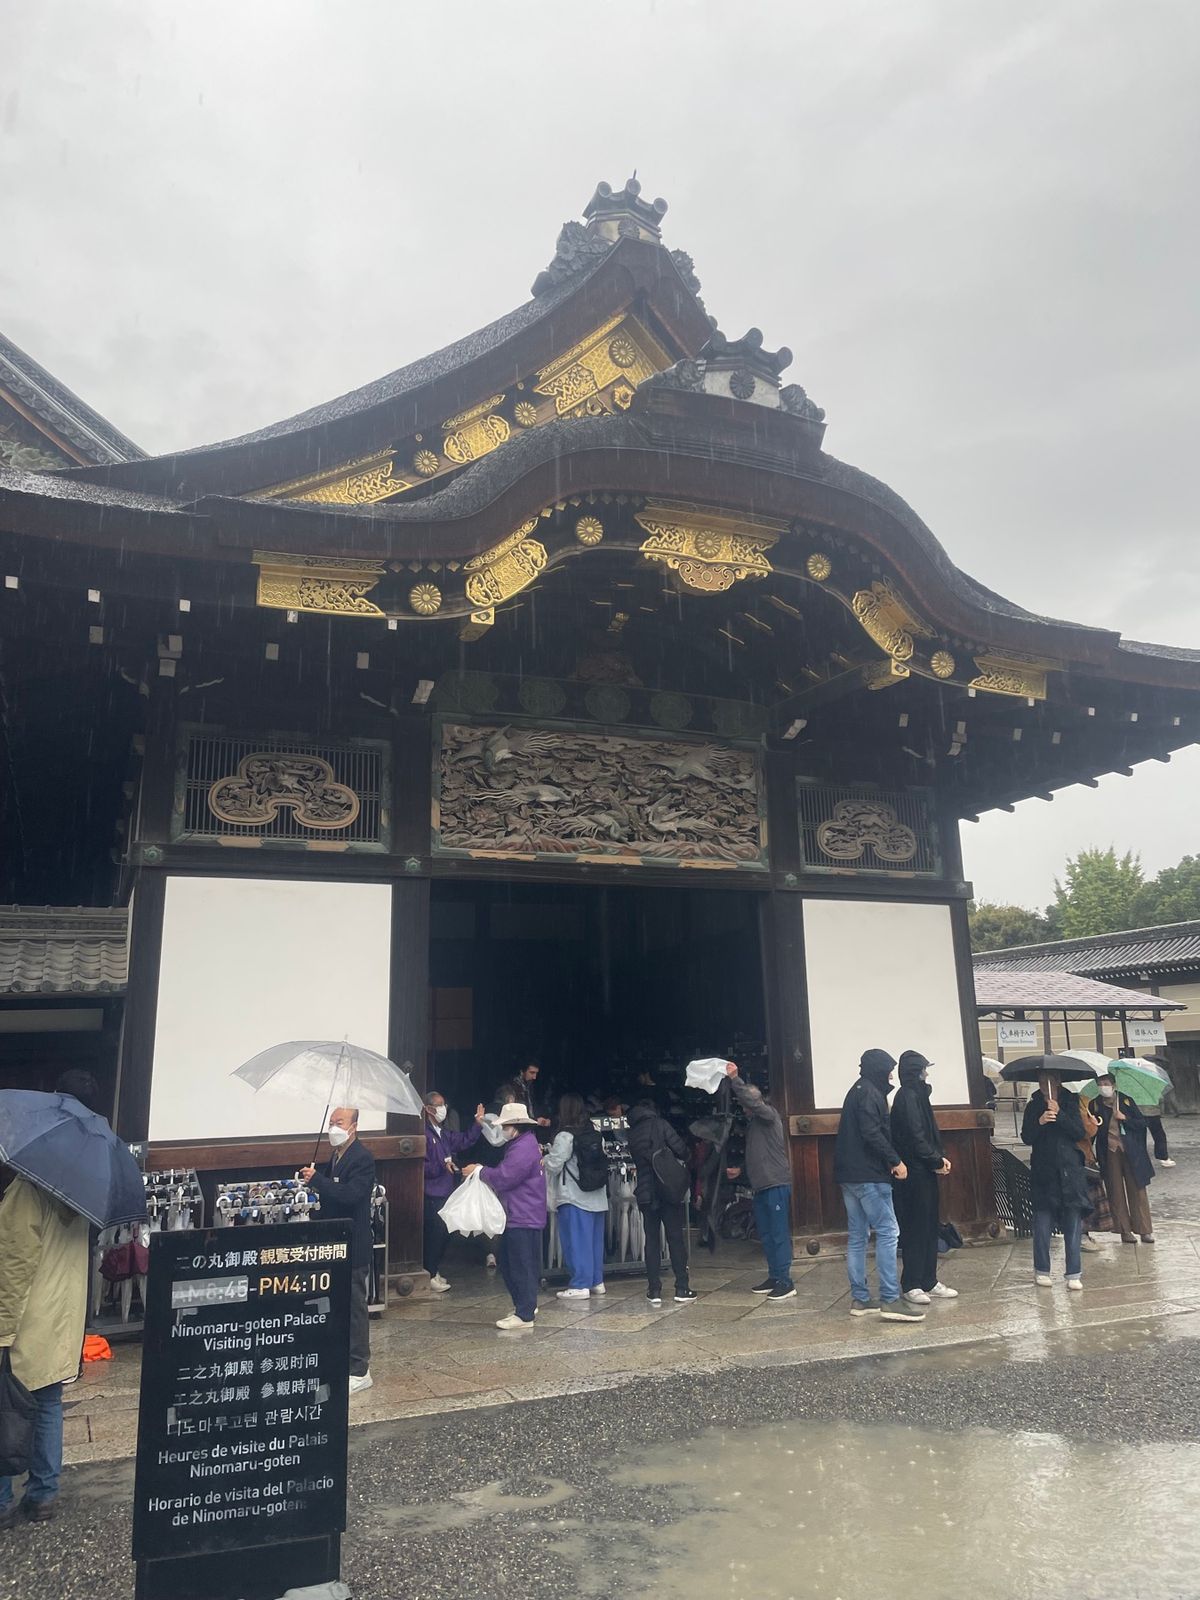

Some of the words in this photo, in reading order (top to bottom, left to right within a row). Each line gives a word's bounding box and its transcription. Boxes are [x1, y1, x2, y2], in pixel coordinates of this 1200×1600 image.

[171, 1317, 281, 1338] Ninomaru-goten
[284, 1312, 327, 1327] Palace
[204, 1334, 252, 1352] Visiting
[255, 1332, 295, 1348] Hours
[176, 1360, 254, 1381] 二之丸御殿
[259, 1353, 319, 1374] 参观时间
[261, 1377, 320, 1399] 參觀時間
[264, 1404, 323, 1426] 관람시간
[158, 1448, 208, 1465] Heures
[211, 1444, 228, 1459] de
[230, 1440, 266, 1456] visite
[268, 1437, 286, 1452] du
[288, 1431, 328, 1449] Palais
[190, 1454, 301, 1478] Ninomaru-goten
[148, 1493, 202, 1511] Horario
[204, 1490, 222, 1505] de
[224, 1486, 260, 1502] visita
[263, 1481, 284, 1497] del
[286, 1475, 334, 1494] Palacio
[172, 1512, 189, 1526] de
